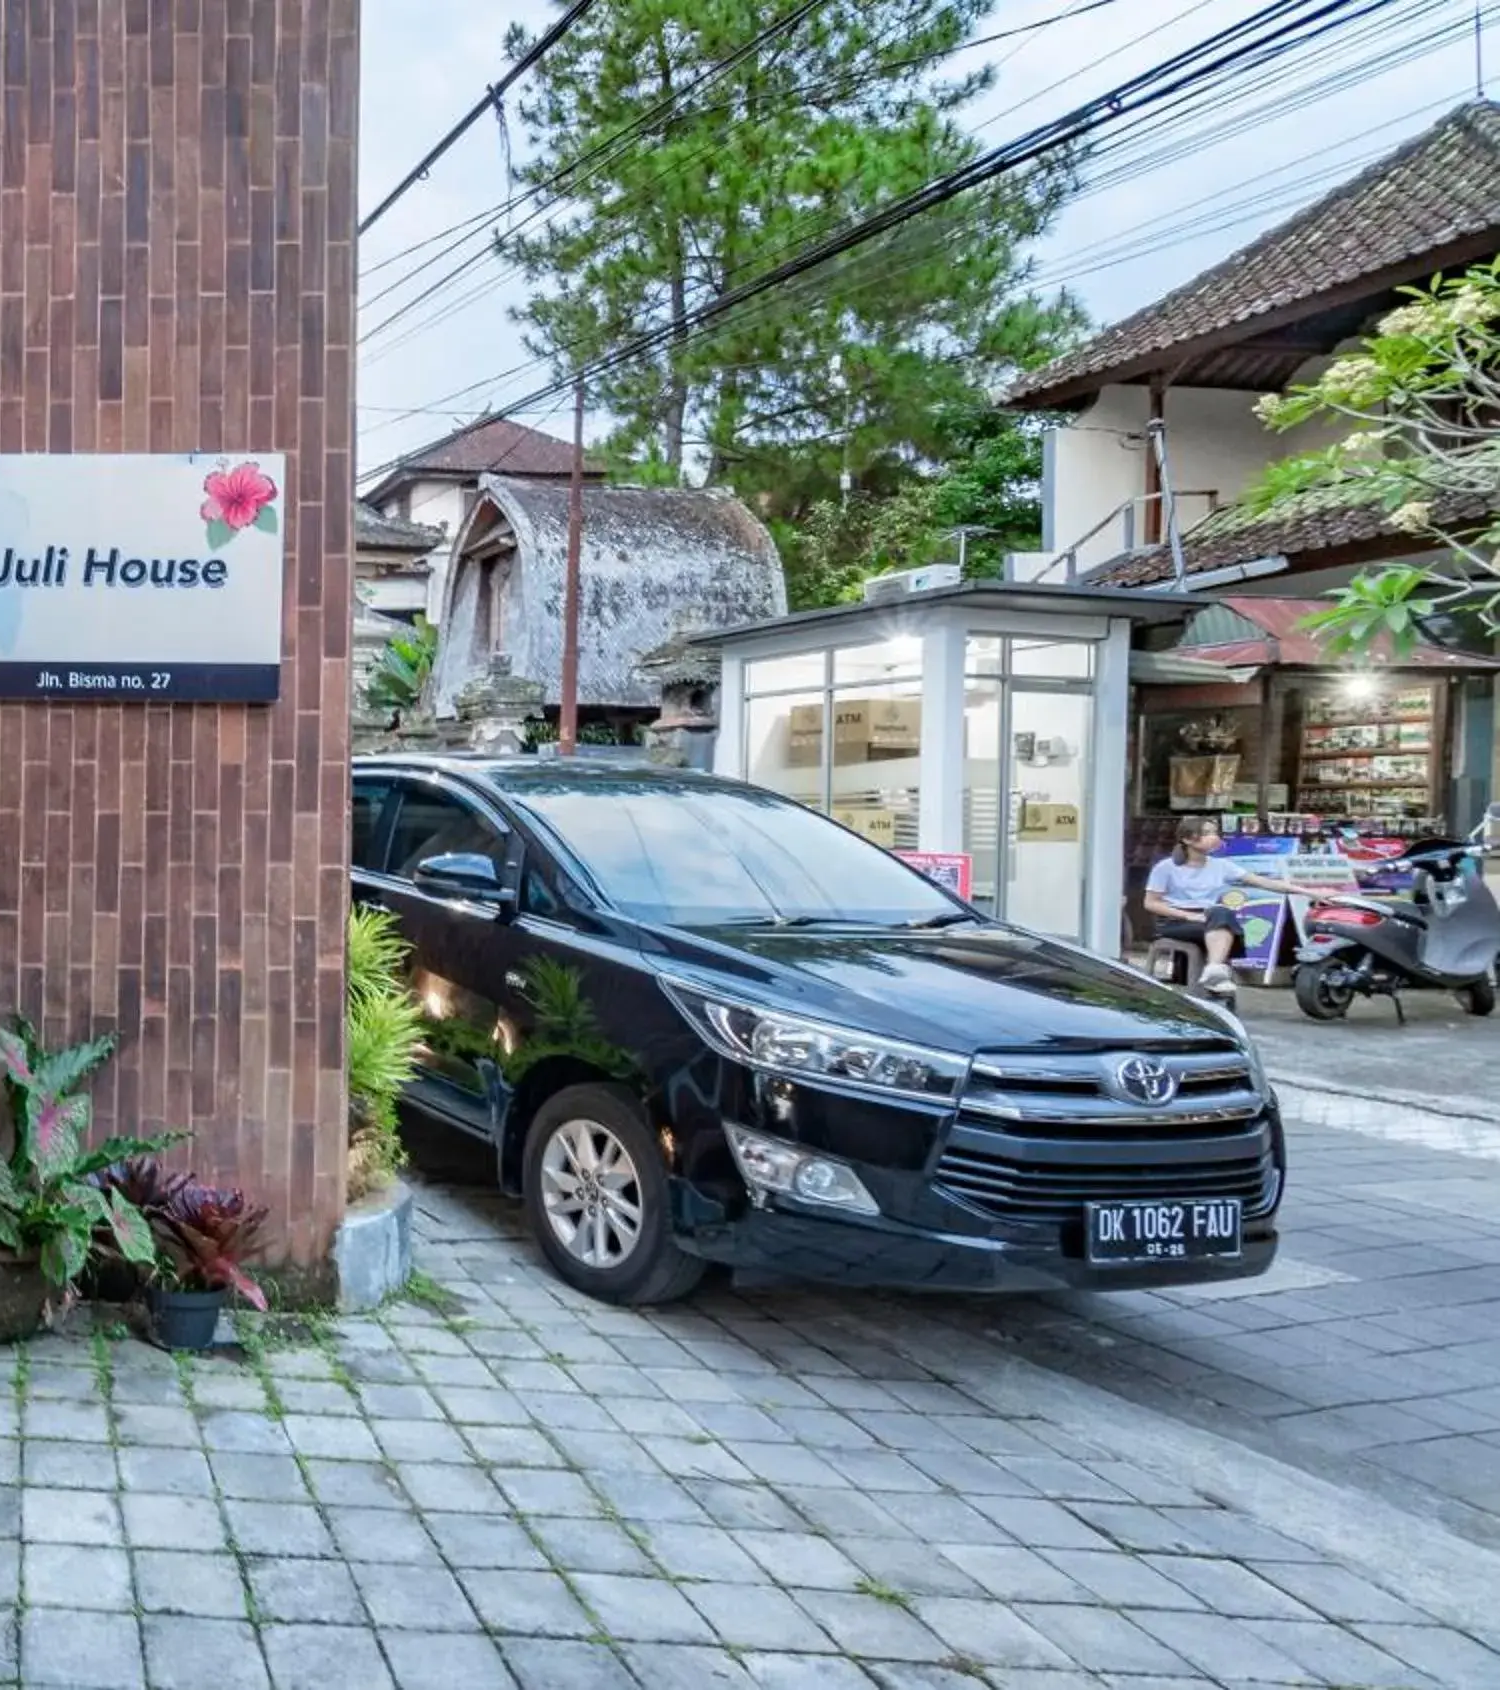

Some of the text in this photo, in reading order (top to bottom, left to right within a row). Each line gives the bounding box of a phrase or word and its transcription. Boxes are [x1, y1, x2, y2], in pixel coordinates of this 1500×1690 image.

[83, 546, 229, 588] House
[36, 671, 172, 689] Jln. Bisma no. 27
[835, 712, 862, 725] ATM
[1055, 815, 1077, 825] ATM
[1099, 1205, 1234, 1242] DK 1062 FAU
